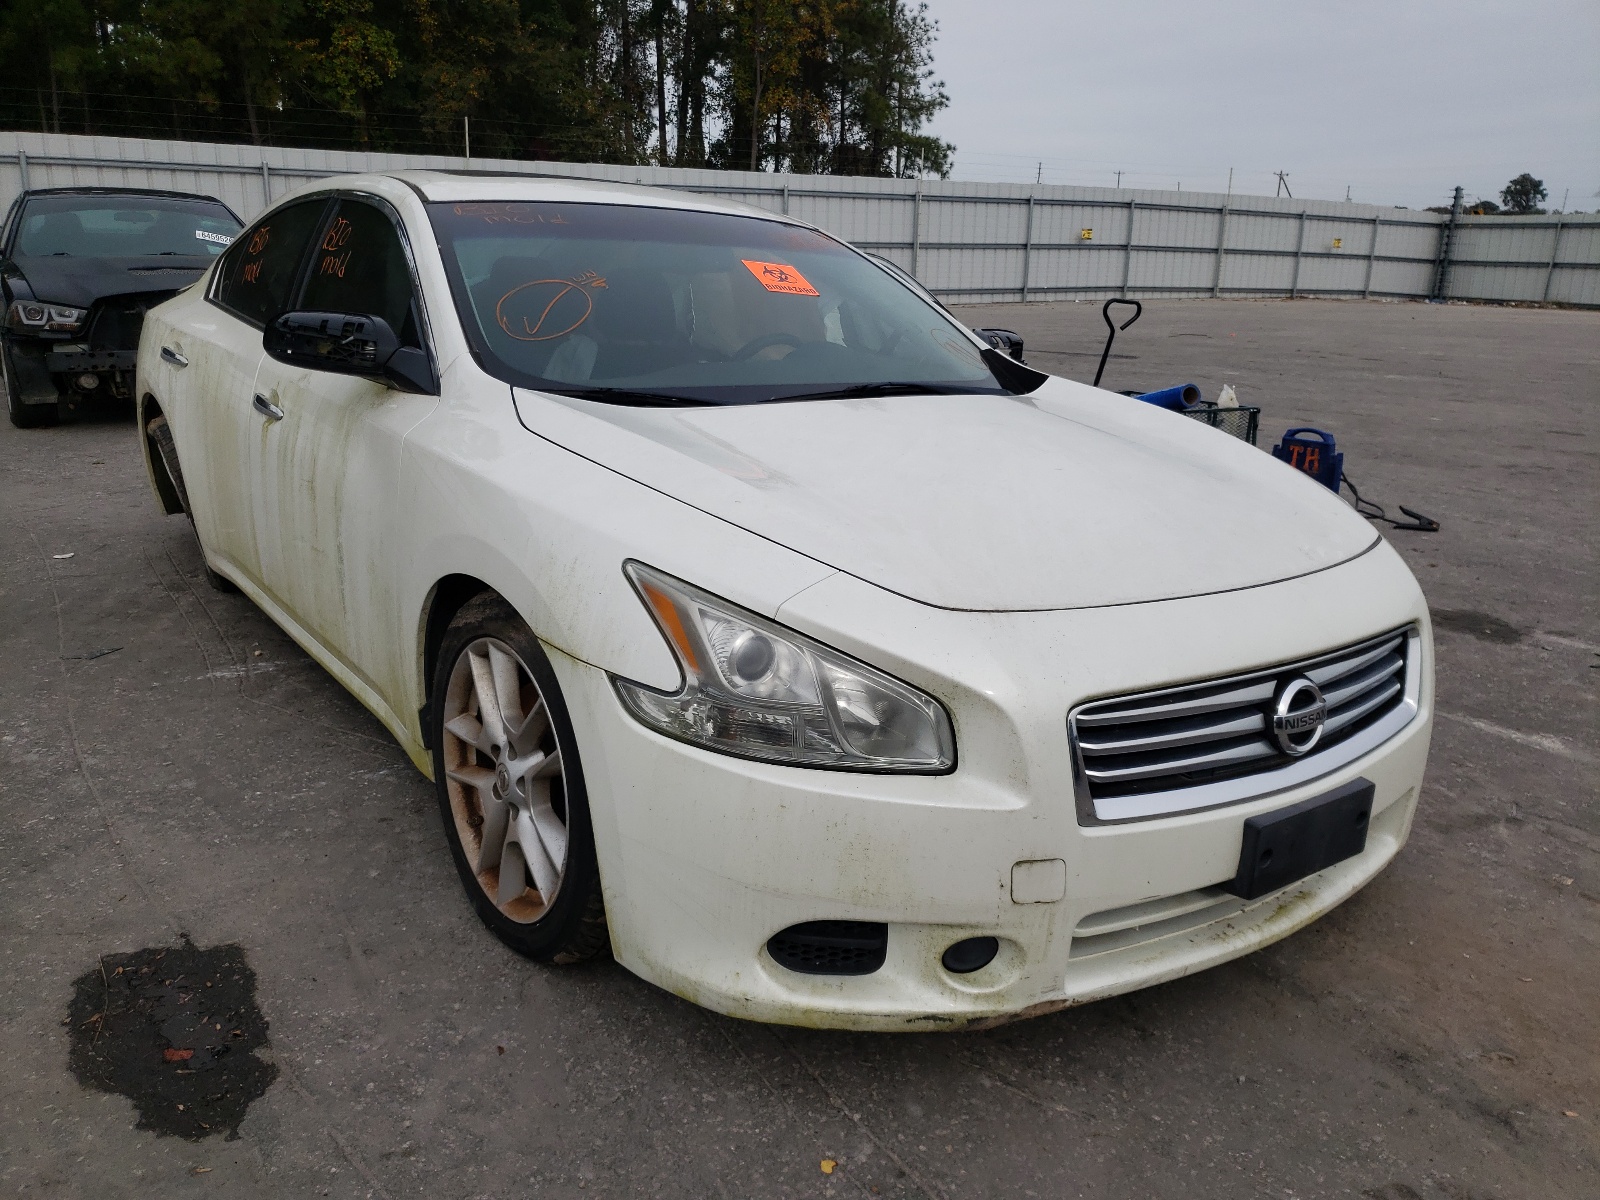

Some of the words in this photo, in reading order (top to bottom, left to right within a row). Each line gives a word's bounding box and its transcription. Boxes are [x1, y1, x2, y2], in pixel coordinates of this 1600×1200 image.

[764, 283, 818, 295] BIOHAZARD
[1289, 445, 1320, 473] TH
[1284, 708, 1327, 731] NISSAN
